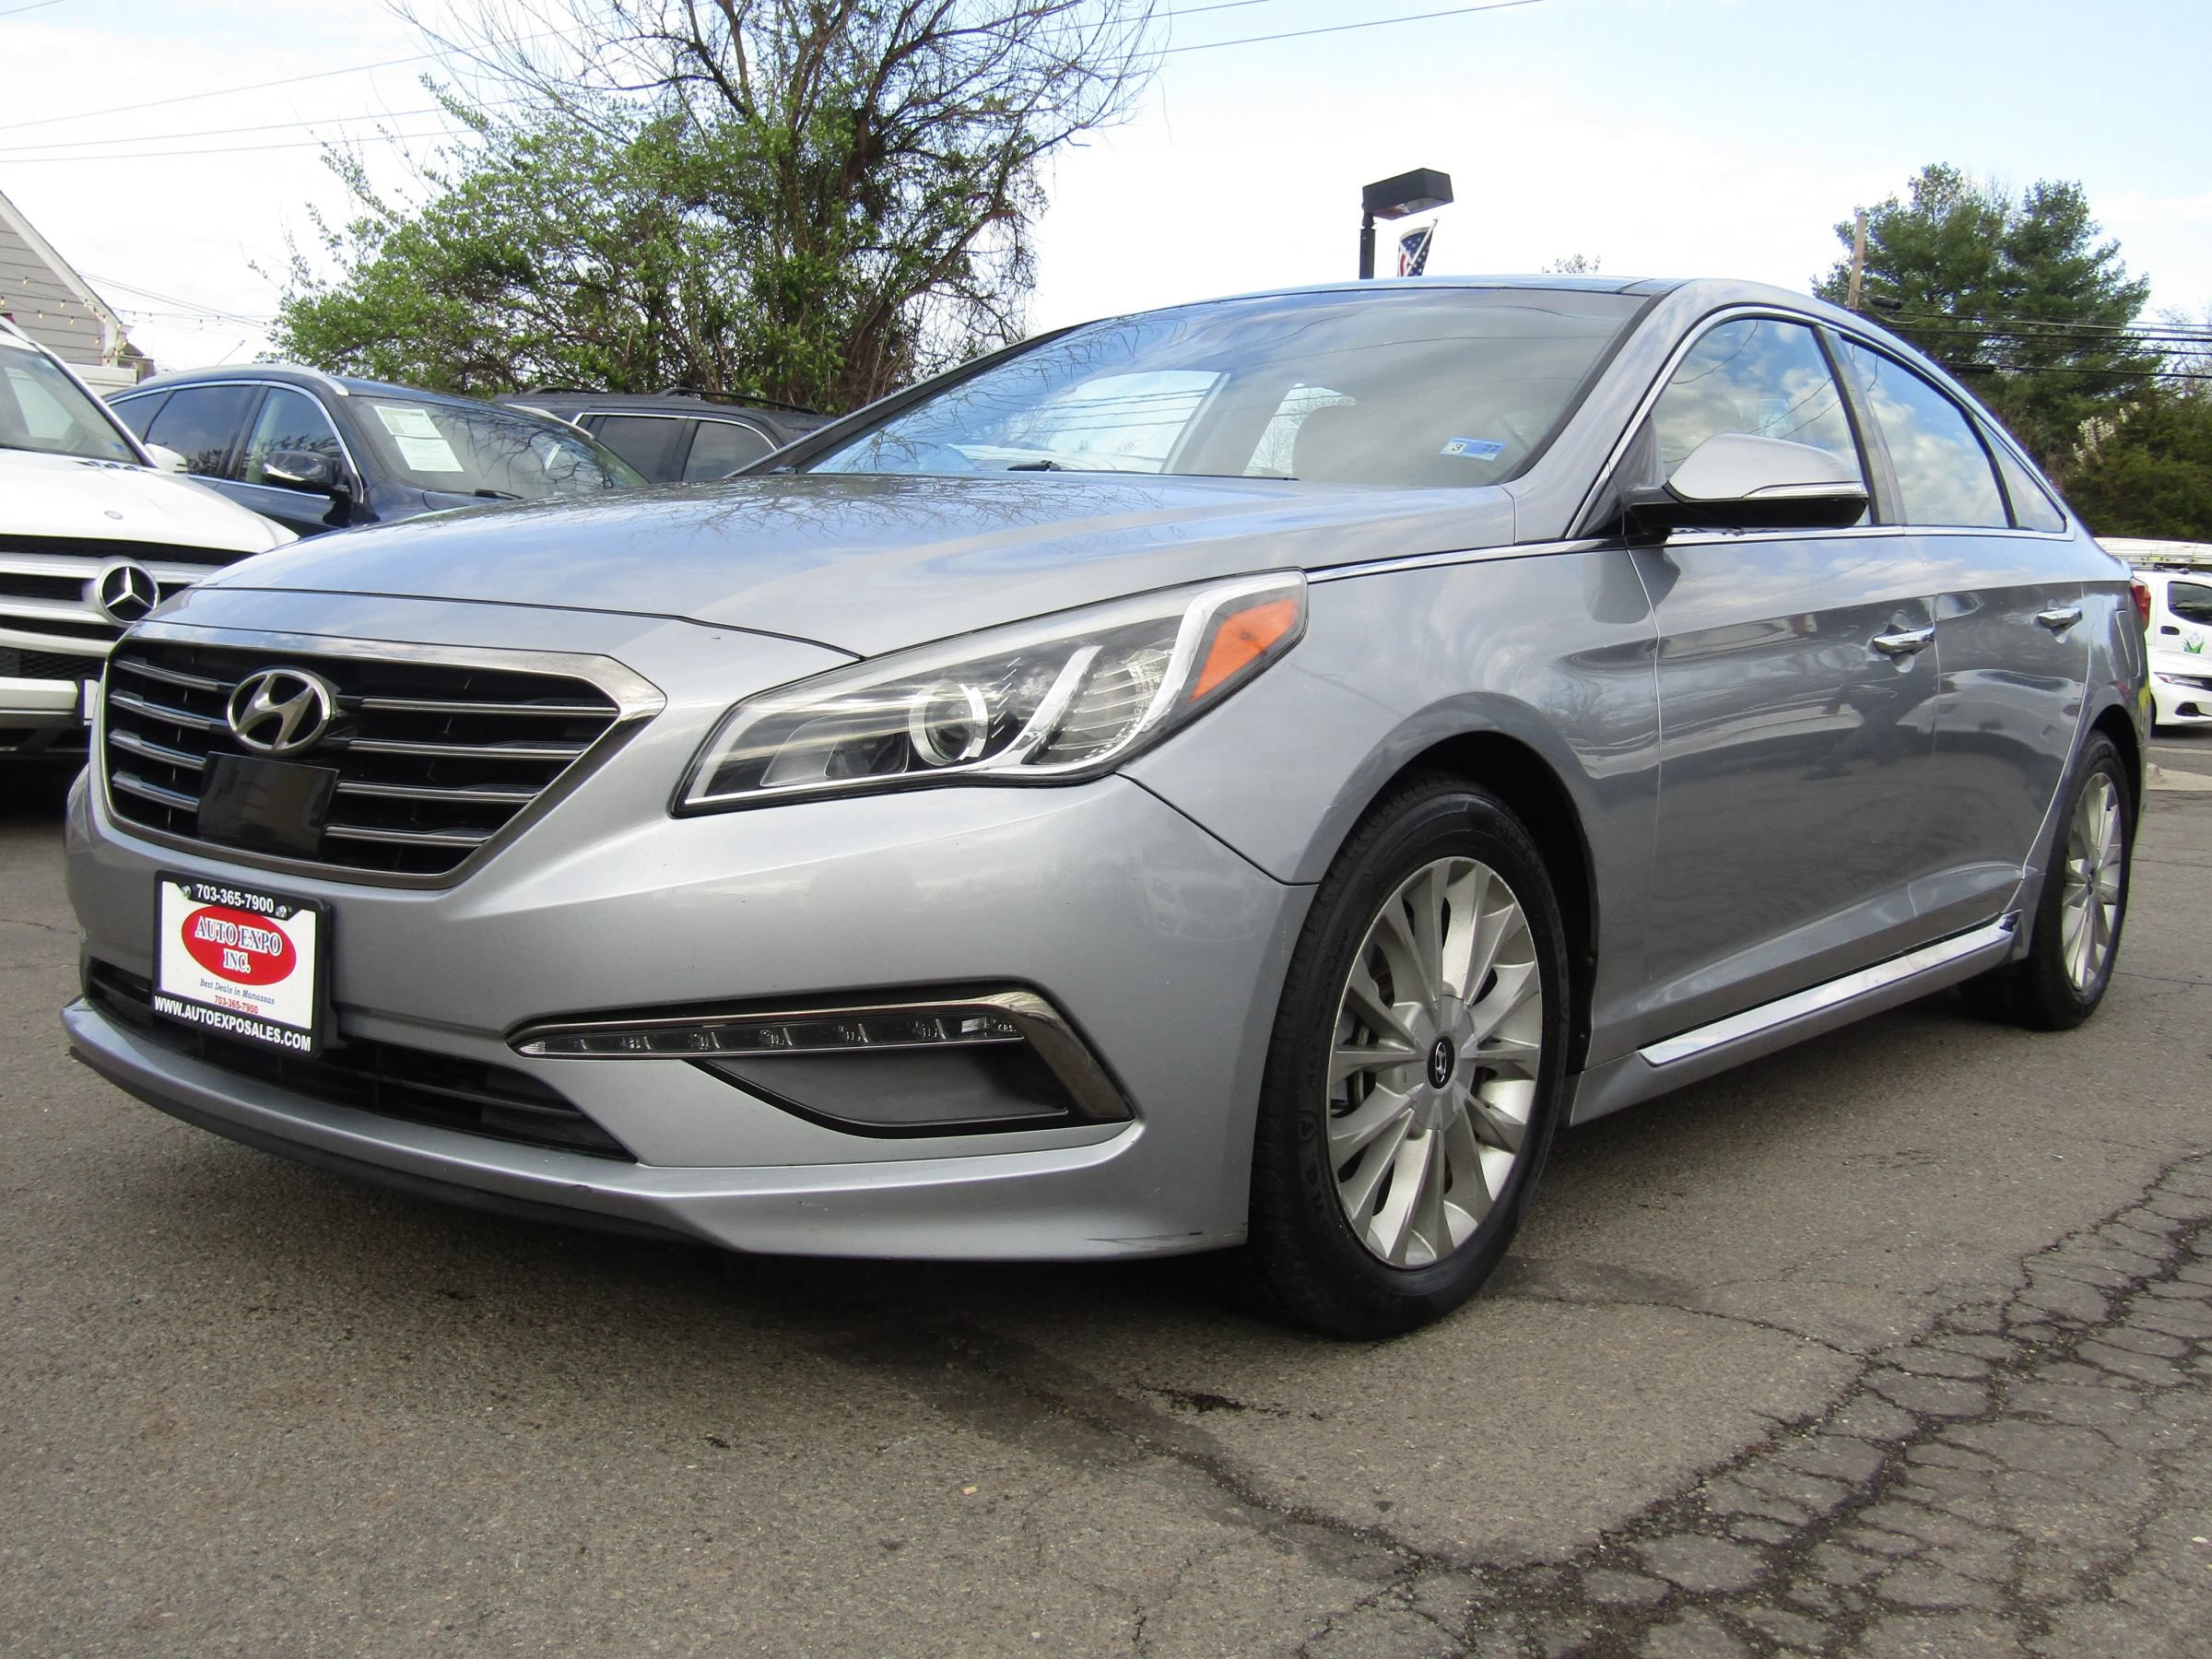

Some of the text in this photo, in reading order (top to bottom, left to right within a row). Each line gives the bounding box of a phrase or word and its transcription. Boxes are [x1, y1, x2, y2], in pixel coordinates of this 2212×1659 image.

[196, 883, 275, 914] 703-365-7900
[195, 918, 282, 957] AUTO EXPO
[223, 948, 252, 973] INC.
[200, 978, 276, 1006] Best Deals in Manassas
[214, 994, 259, 1015] 703-365-7900
[154, 994, 312, 1053] WWW.AUTOEXPOSALES.COM
